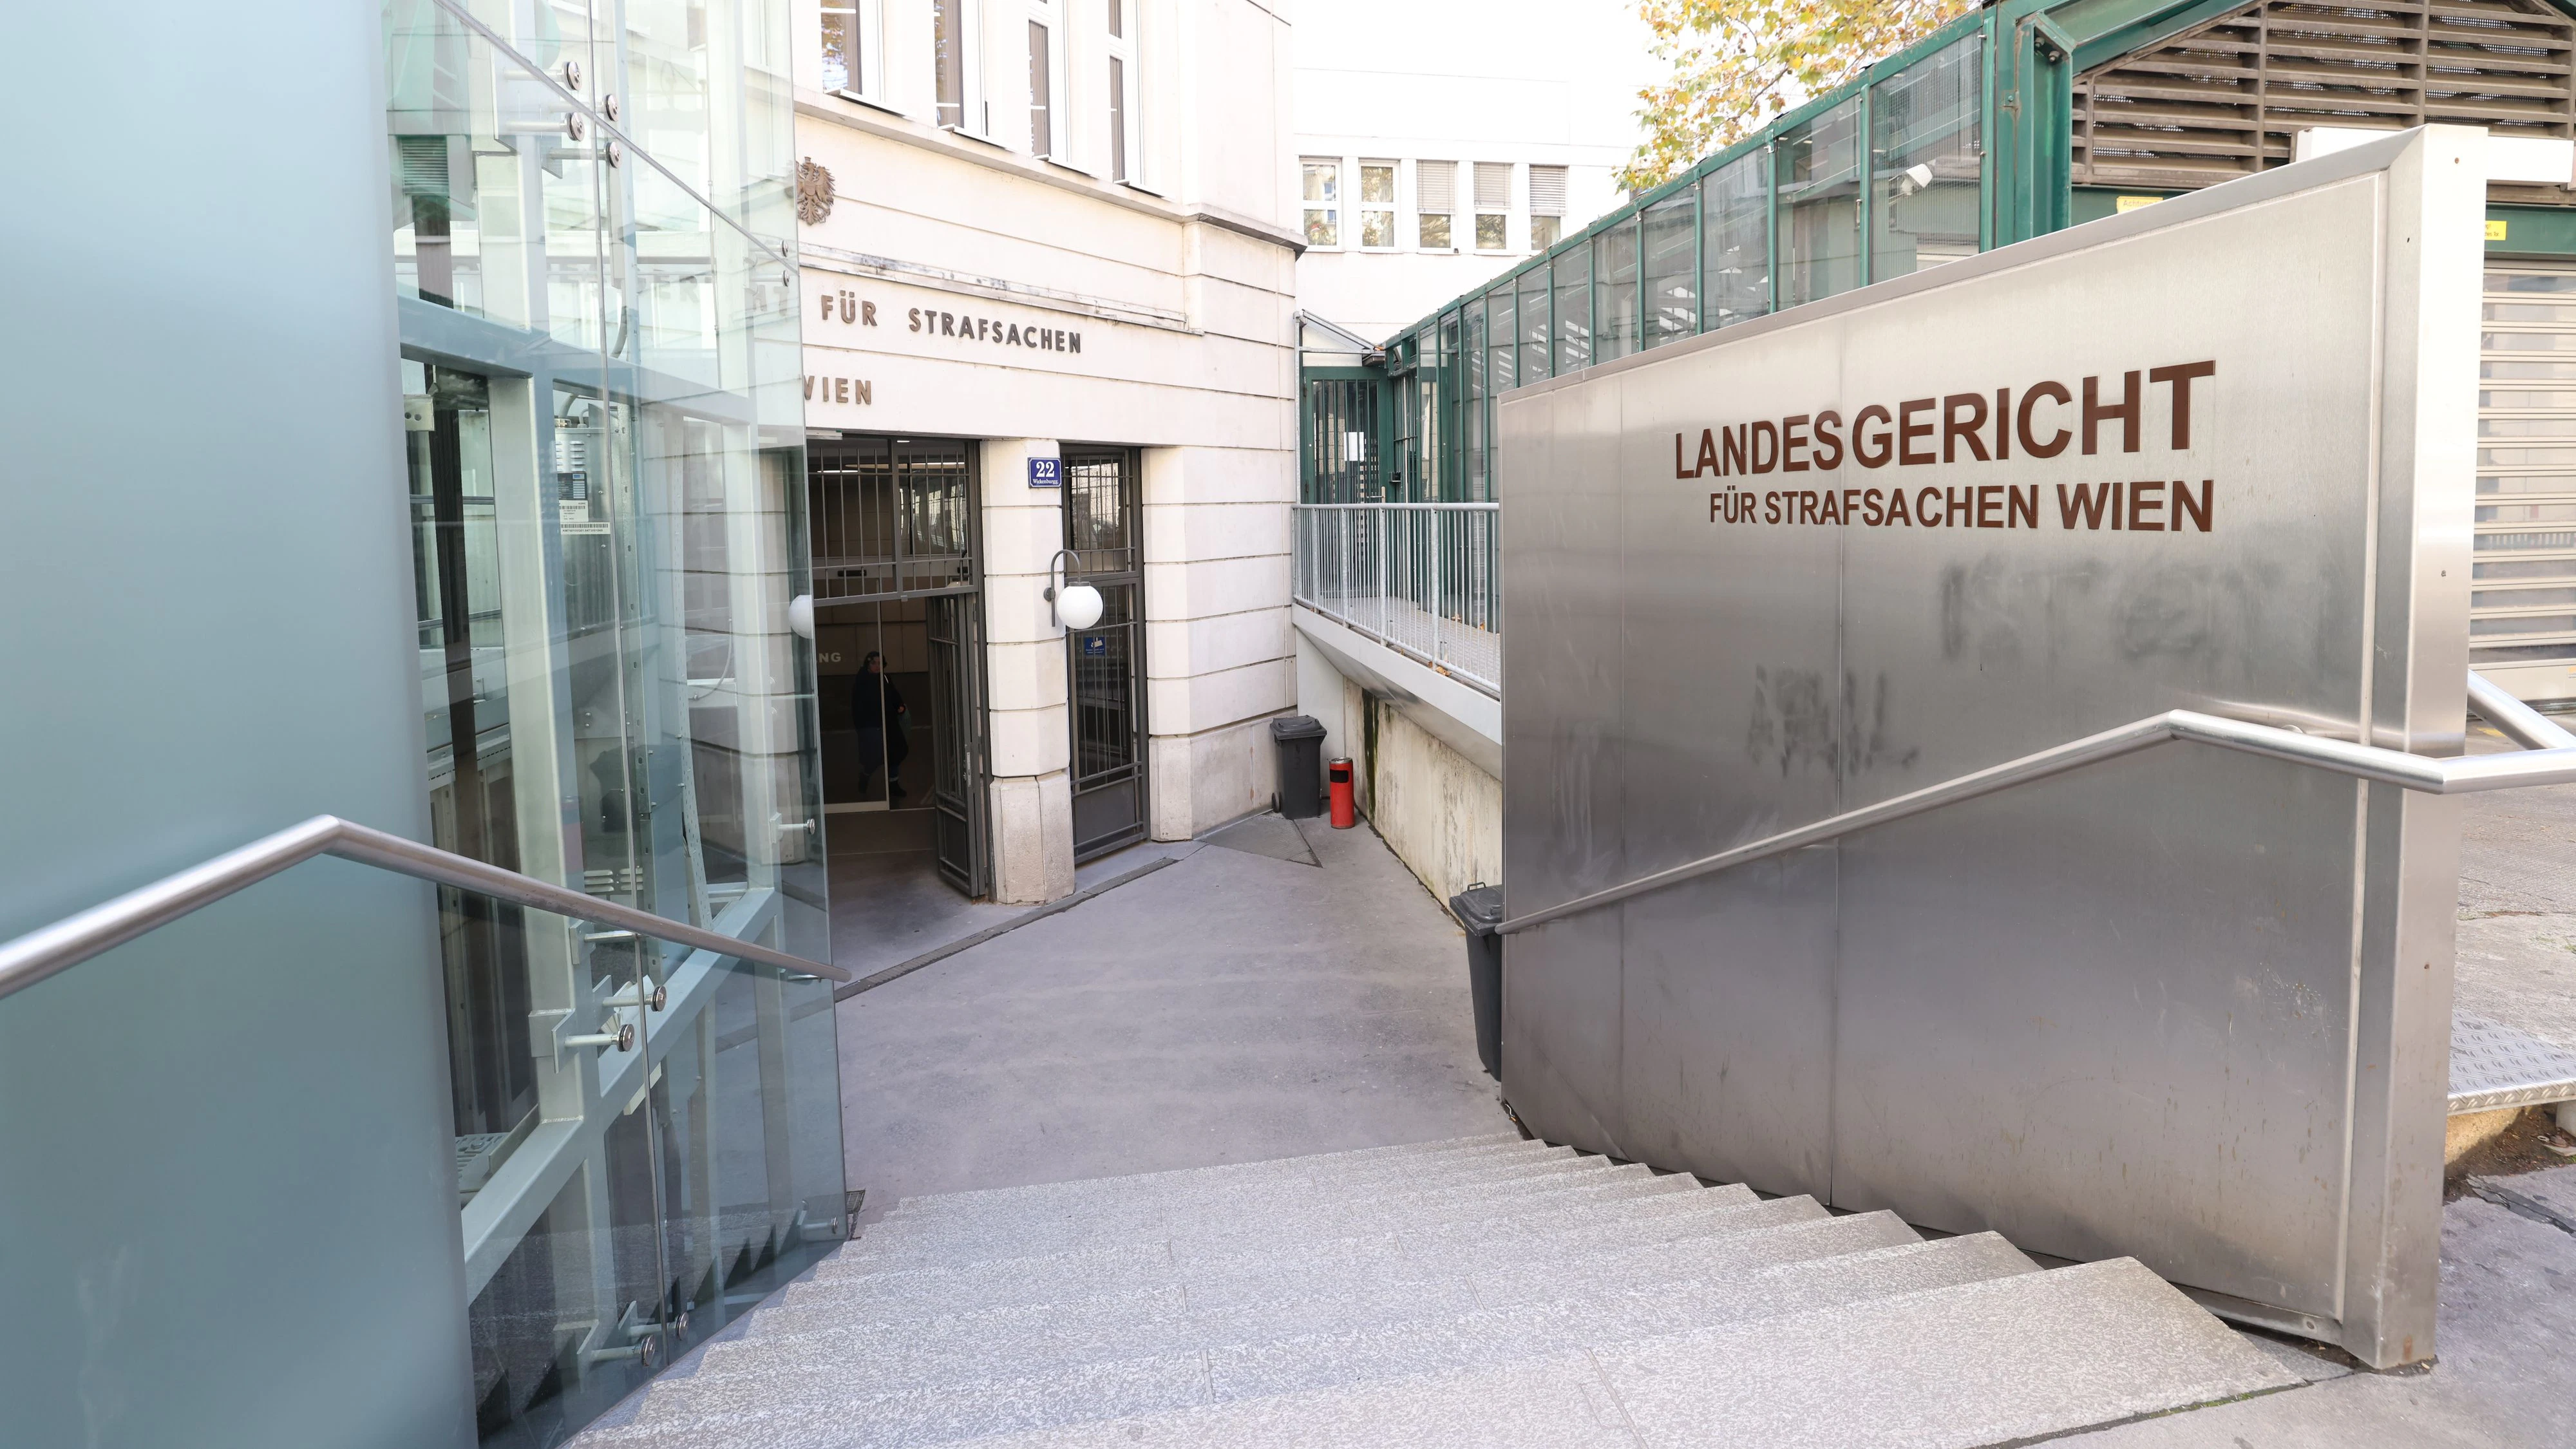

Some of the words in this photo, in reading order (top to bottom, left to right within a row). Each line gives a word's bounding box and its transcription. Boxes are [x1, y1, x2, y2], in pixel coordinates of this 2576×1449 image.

[821, 290, 878, 327] FÜR
[909, 307, 1081, 354] STRAFSACHEN
[1676, 360, 2216, 479] LANDESGERICHT
[1036, 461, 1055, 477] 22
[1710, 485, 1757, 524] FÜR
[1765, 484, 2039, 529] STRAFSACHEN
[2056, 479, 2214, 532] WIEN
